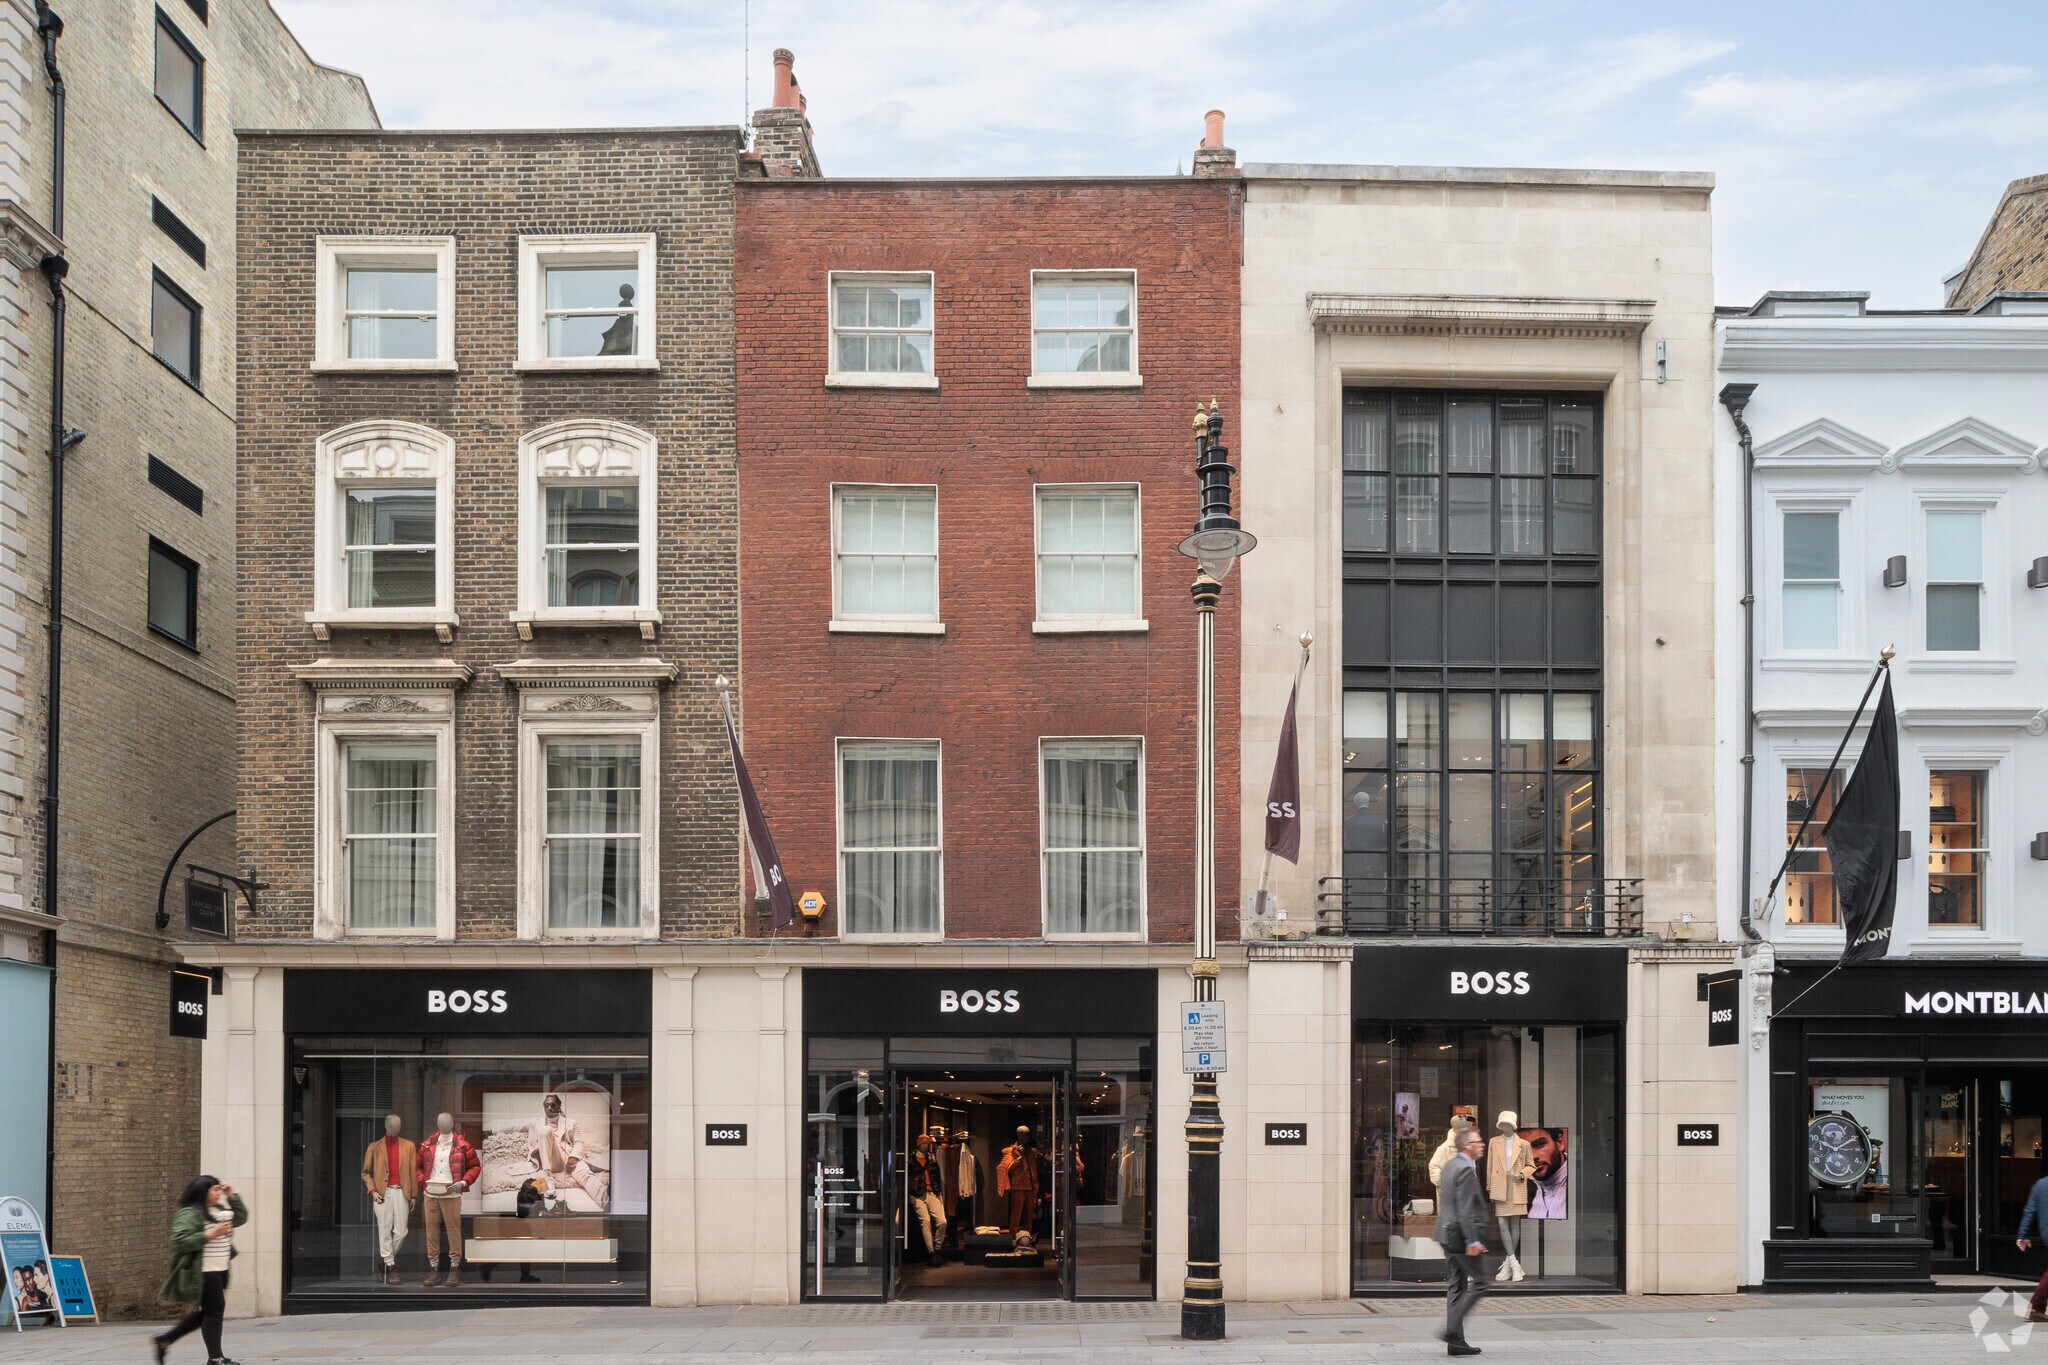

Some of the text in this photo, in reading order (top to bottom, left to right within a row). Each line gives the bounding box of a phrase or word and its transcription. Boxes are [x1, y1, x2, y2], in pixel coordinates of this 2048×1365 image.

[1265, 801, 1296, 818] SS
[804, 900, 816, 908] ADT
[1450, 971, 1531, 995] BOSS
[428, 989, 508, 1013] BOSS
[940, 989, 1020, 1013] BOSS
[1904, 991, 2048, 1014] MONTBLA
[178, 1000, 204, 1016] BOSS
[1711, 1008, 1732, 1024] BOSS
[1201, 1054, 1209, 1064] P
[1941, 1100, 1959, 1108] BLANC
[711, 1130, 741, 1139] BOSS
[1271, 1129, 1301, 1139] BOSS
[1684, 1130, 1713, 1140] BOSS
[6, 1222, 33, 1230] ELEMIS
[63, 1288, 86, 1297] OPEN!
